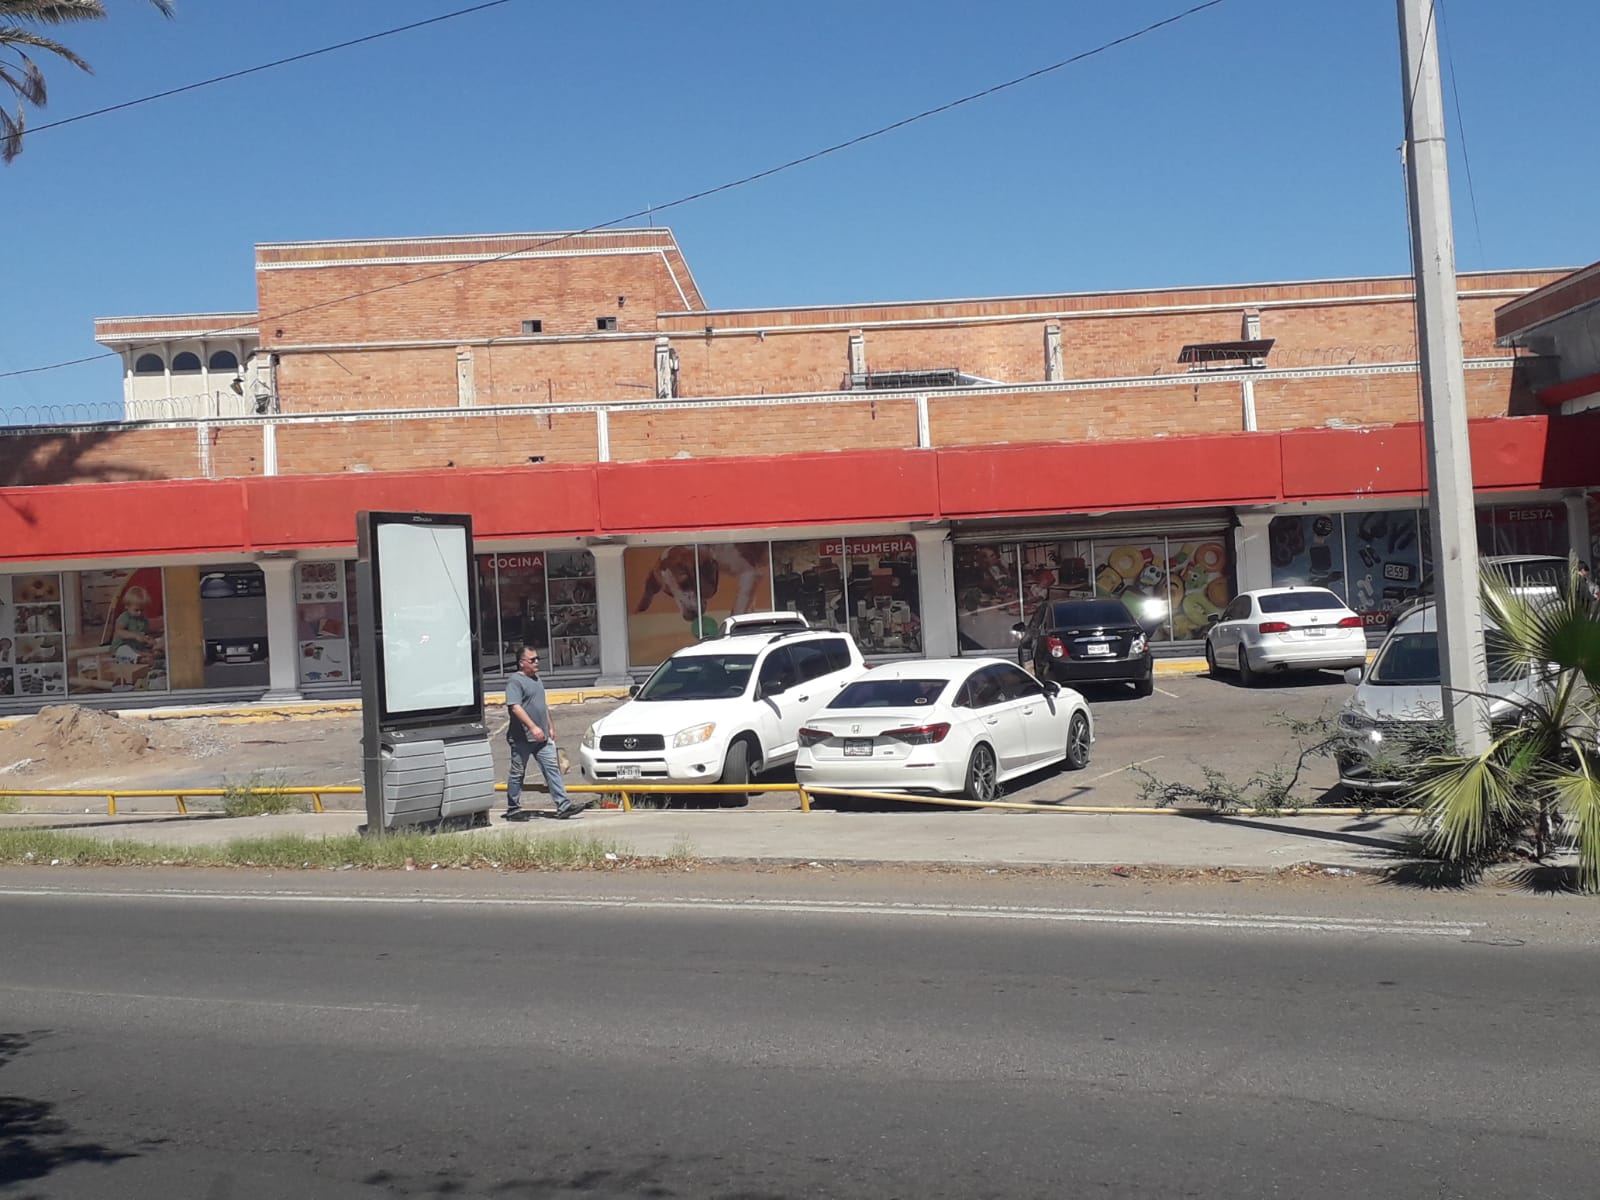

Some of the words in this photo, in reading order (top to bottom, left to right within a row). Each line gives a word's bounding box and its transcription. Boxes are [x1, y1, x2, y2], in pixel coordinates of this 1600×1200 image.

[1509, 509, 1553, 521] FIESTA
[825, 540, 914, 555] PERFUMERÍA
[487, 556, 543, 569] COCINA
[1359, 611, 1390, 625] TRÓ
